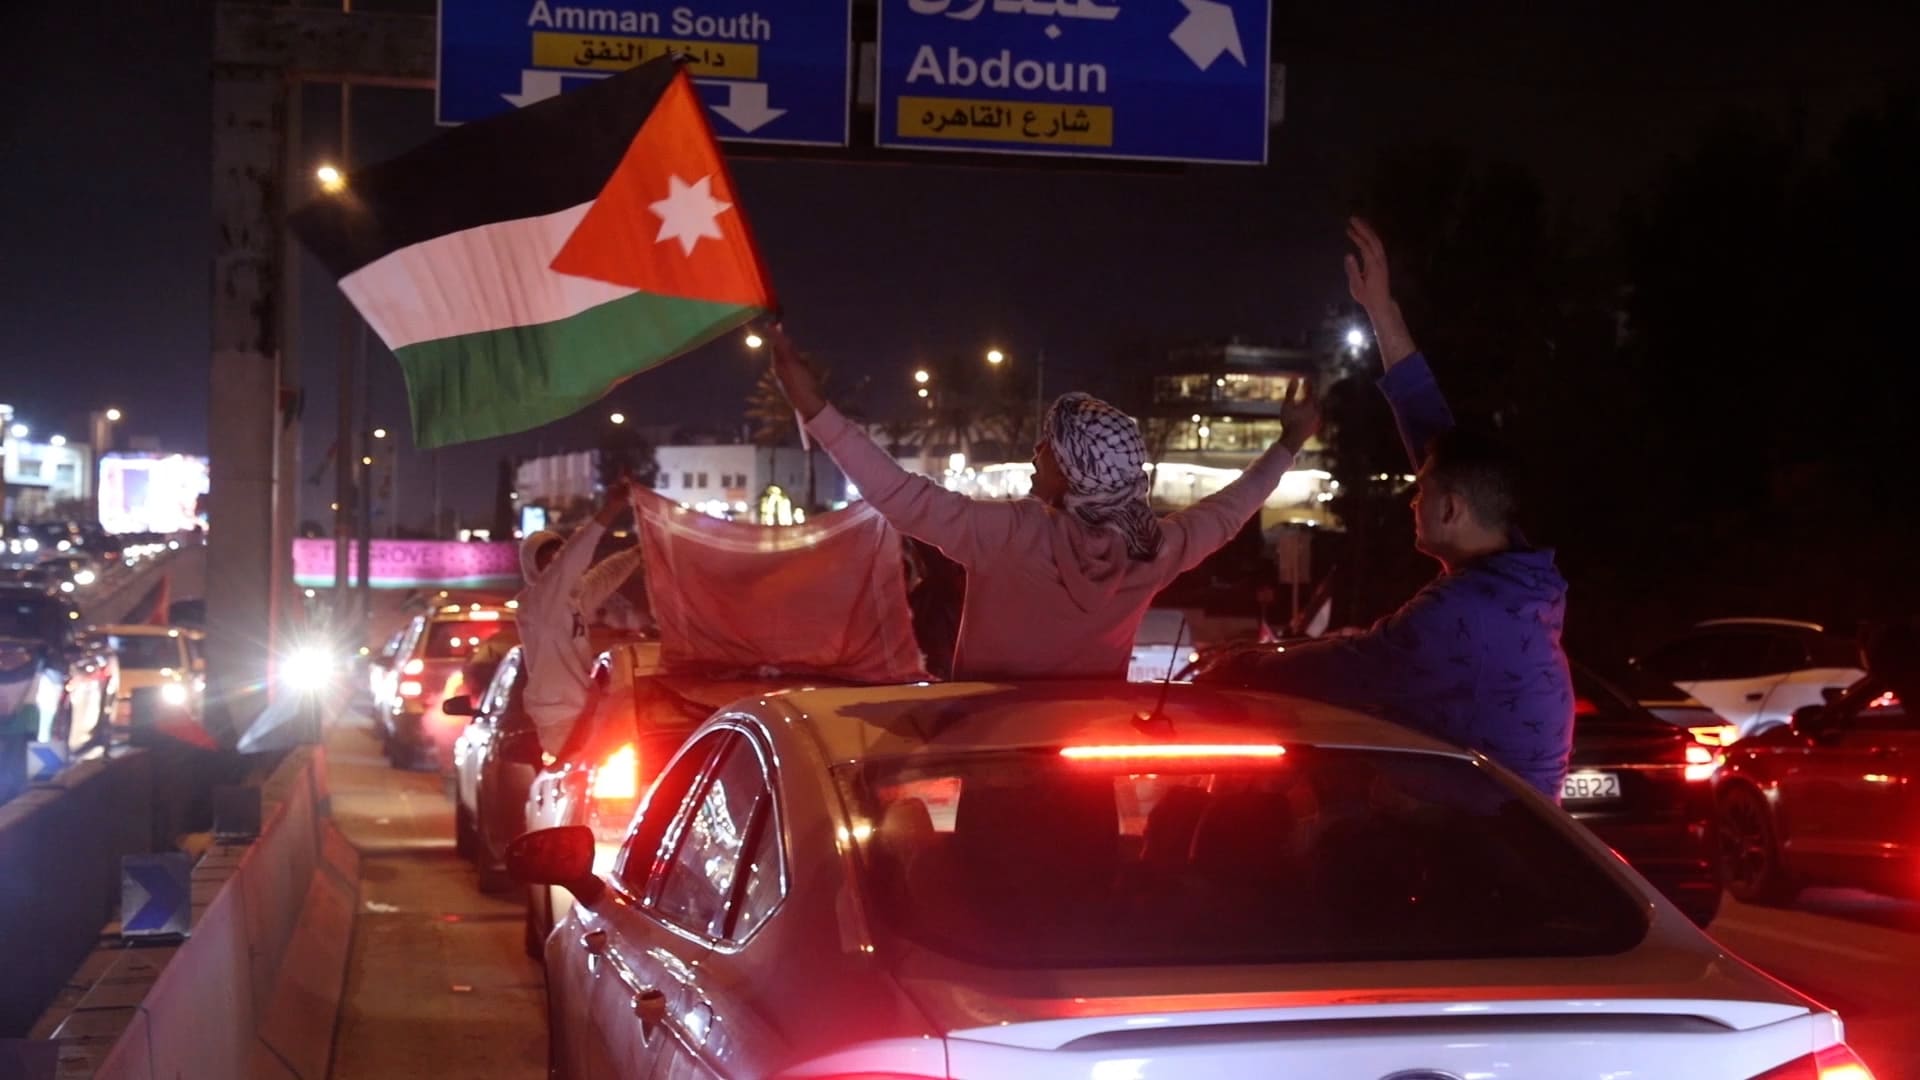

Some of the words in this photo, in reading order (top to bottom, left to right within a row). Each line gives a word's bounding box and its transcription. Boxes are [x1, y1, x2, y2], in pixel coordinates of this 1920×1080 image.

[527, 0, 660, 34] Amman
[671, 7, 771, 41] South
[574, 40, 643, 66] النفق
[906, 44, 1108, 93] Abdoun
[1023, 108, 1091, 138] شارع
